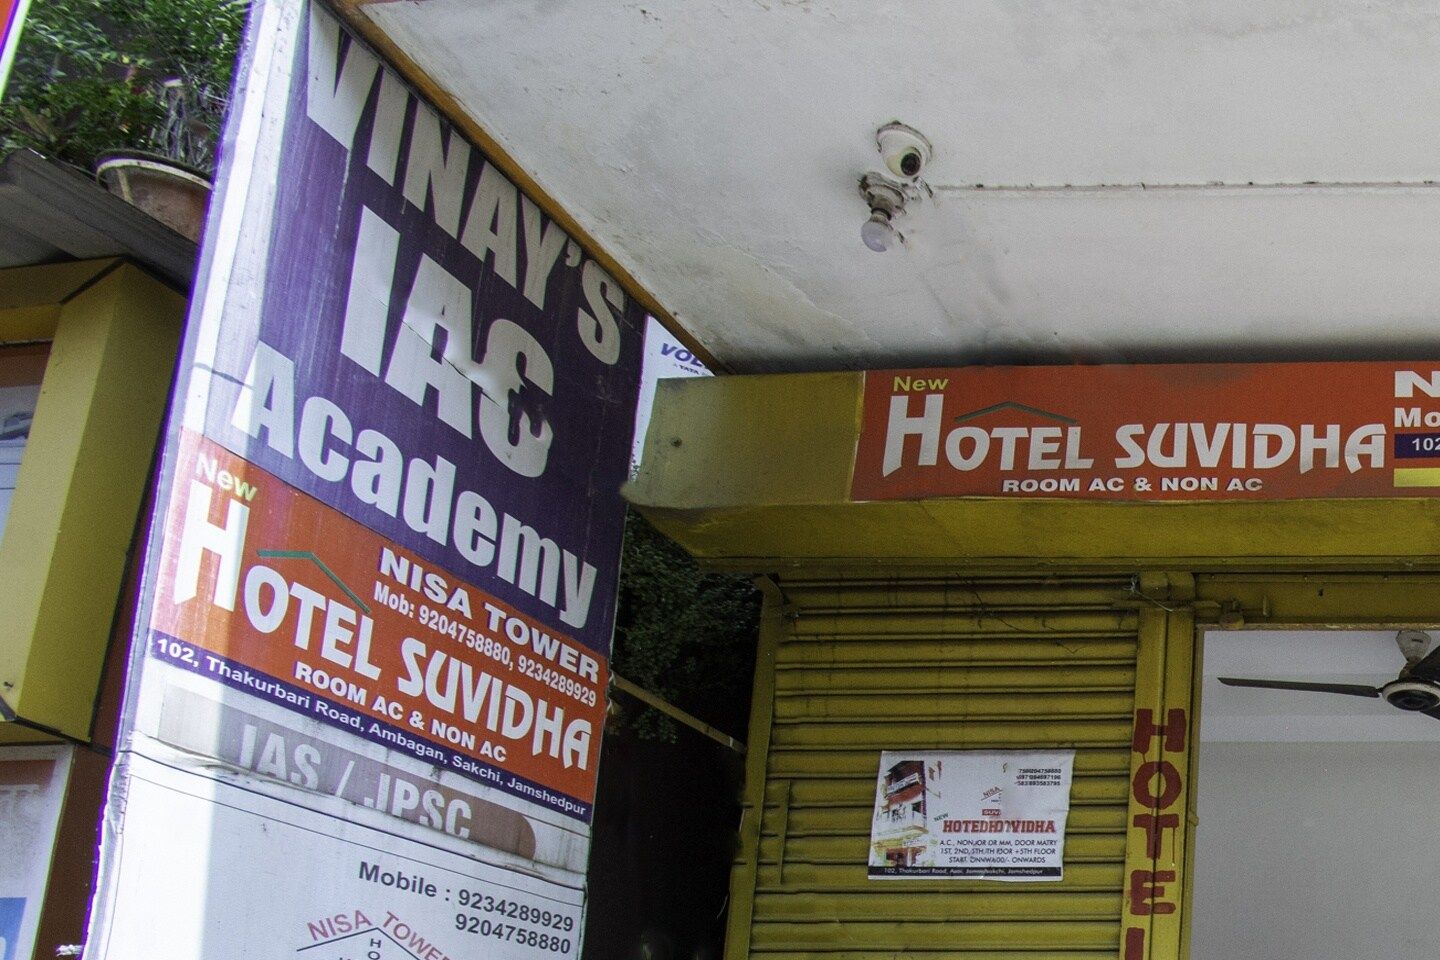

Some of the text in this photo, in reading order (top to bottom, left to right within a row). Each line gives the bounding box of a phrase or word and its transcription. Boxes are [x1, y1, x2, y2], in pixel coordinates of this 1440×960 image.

[306, 8, 626, 366] VINAY'S
[892, 375, 949, 393] New
[882, 393, 1388, 478] HOTEL SUVIDHA
[194, 452, 258, 502] New
[230, 339, 597, 629] Academy
[1001, 477, 1264, 494] ROOM AC & NON AC
[174, 480, 593, 774] HOTEL SUVIDHA
[373, 581, 597, 707] Mob: 9204758880, 9234289929
[379, 547, 600, 684] NISA TOWER
[156, 637, 587, 817] 102, Thakurbari Road, Ambagan, Sakchi, Jamshedpur
[294, 661, 508, 763] ROOM AC & NON AC
[933, 813, 950, 823] NEW
[358, 860, 438, 898] Mobile
[457, 887, 574, 933] 9234289929
[1012, 856, 1046, 864] ONWARDS
[306, 908, 373, 942] NISA
[455, 912, 572, 955] 9204758880
